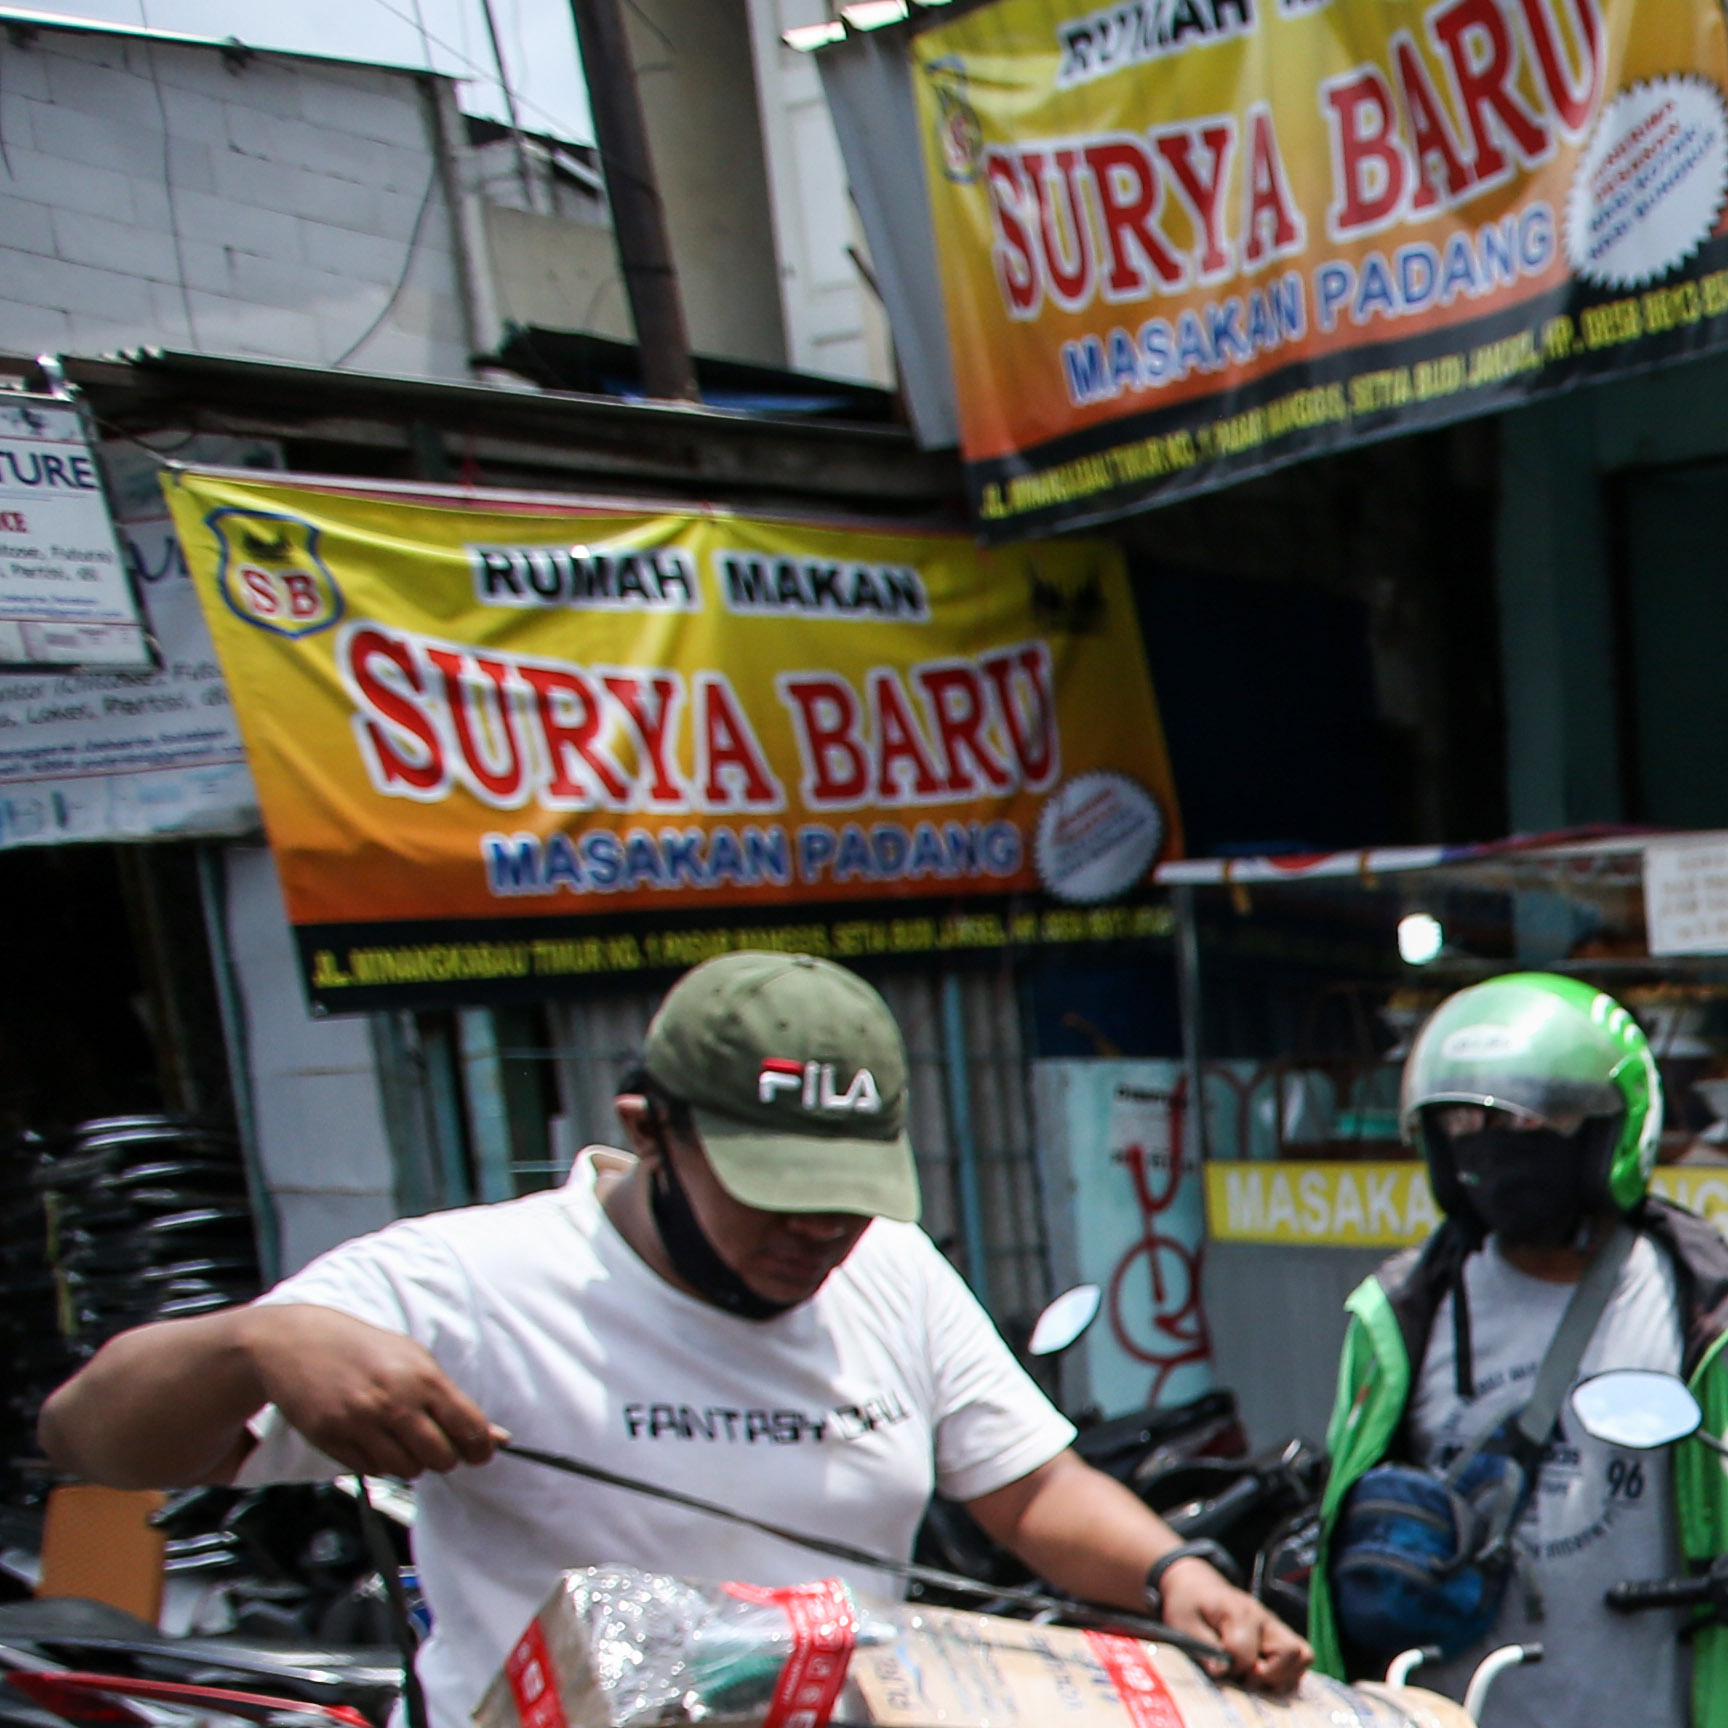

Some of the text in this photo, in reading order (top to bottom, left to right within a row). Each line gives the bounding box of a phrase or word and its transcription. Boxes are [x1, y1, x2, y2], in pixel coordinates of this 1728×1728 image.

[988, 113, 1299, 311] SURYA
[1328, 0, 1602, 234] BARU
[1064, 208, 1553, 402] MASAKAN PADANG
[479, 547, 925, 617] RUMAH MAKAN
[345, 629, 1055, 802] SURYA BARU
[490, 834, 788, 892] MASAKAN
[803, 822, 1020, 879] PADANG
[759, 1058, 882, 1113] FILA
[1225, 1168, 1438, 1238] MASAKA
[624, 1404, 827, 1444] FANTASY
[1608, 1458, 1644, 1500] 96
